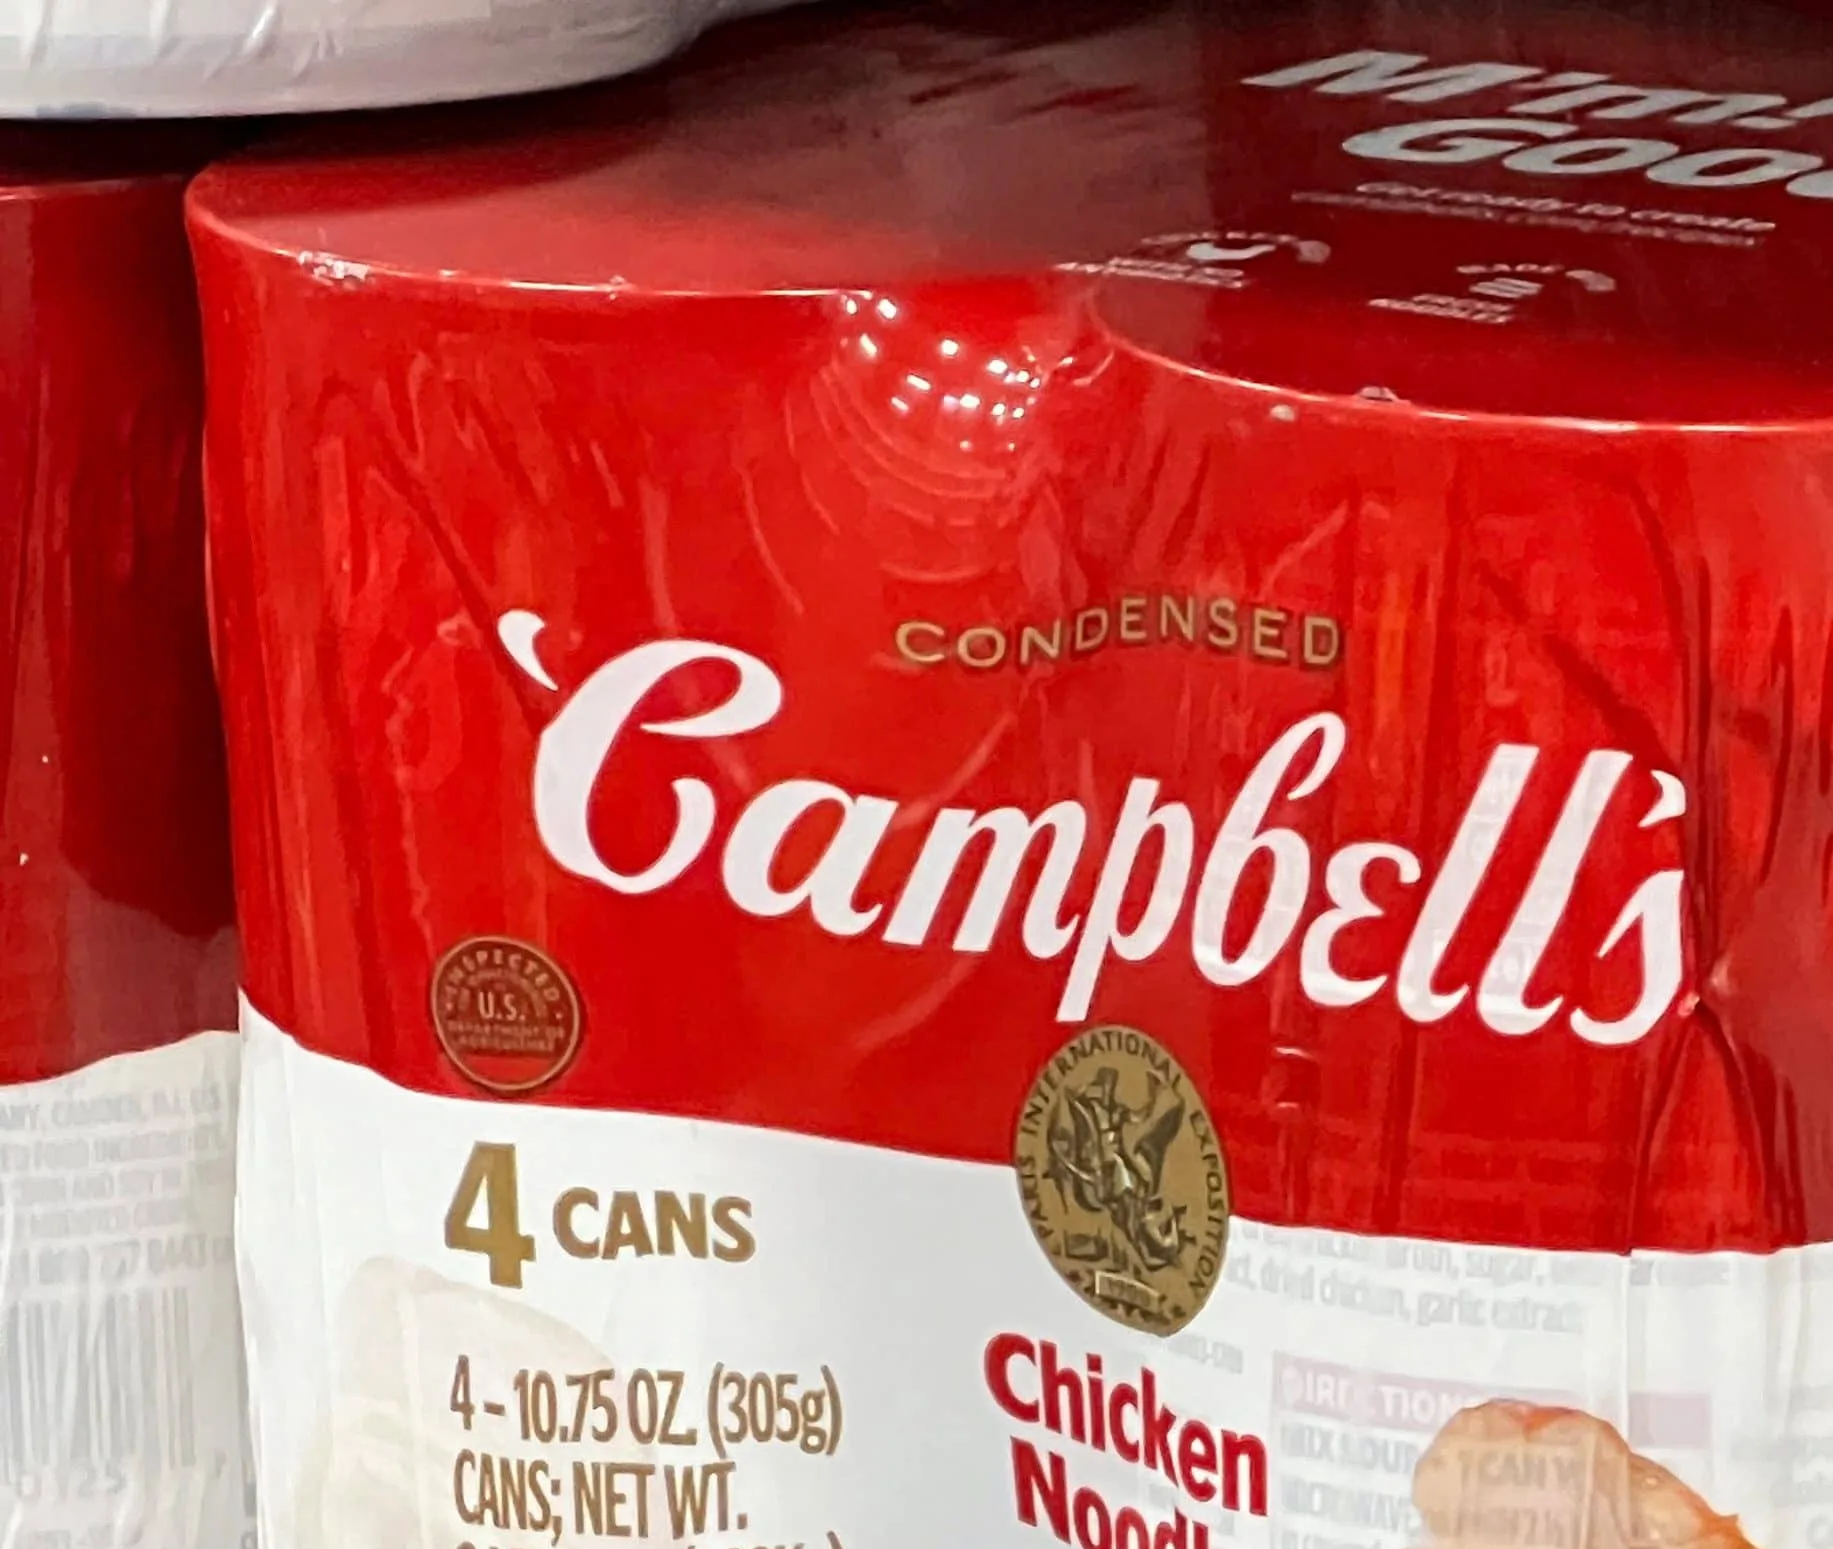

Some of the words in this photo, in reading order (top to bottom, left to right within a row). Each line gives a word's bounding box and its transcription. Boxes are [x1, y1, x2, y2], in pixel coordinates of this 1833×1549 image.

[893, 600, 1344, 668] CONDENSED
[496, 610, 1688, 1045] Campbell's
[478, 990, 527, 1022] U.S.
[444, 1141, 536, 1288] 4
[552, 1187, 757, 1263] CANS
[1019, 1030, 1183, 1137] INTERNATIONAL
[1189, 1109, 1227, 1290] EXPOSITION
[629, 1365, 696, 1447] OZ.
[708, 1362, 843, 1458] (305g)
[984, 1332, 1269, 1517] Chicken
[454, 1449, 563, 1548] CANS;
[573, 1461, 654, 1538] NET
[666, 1459, 748, 1533] WT.
